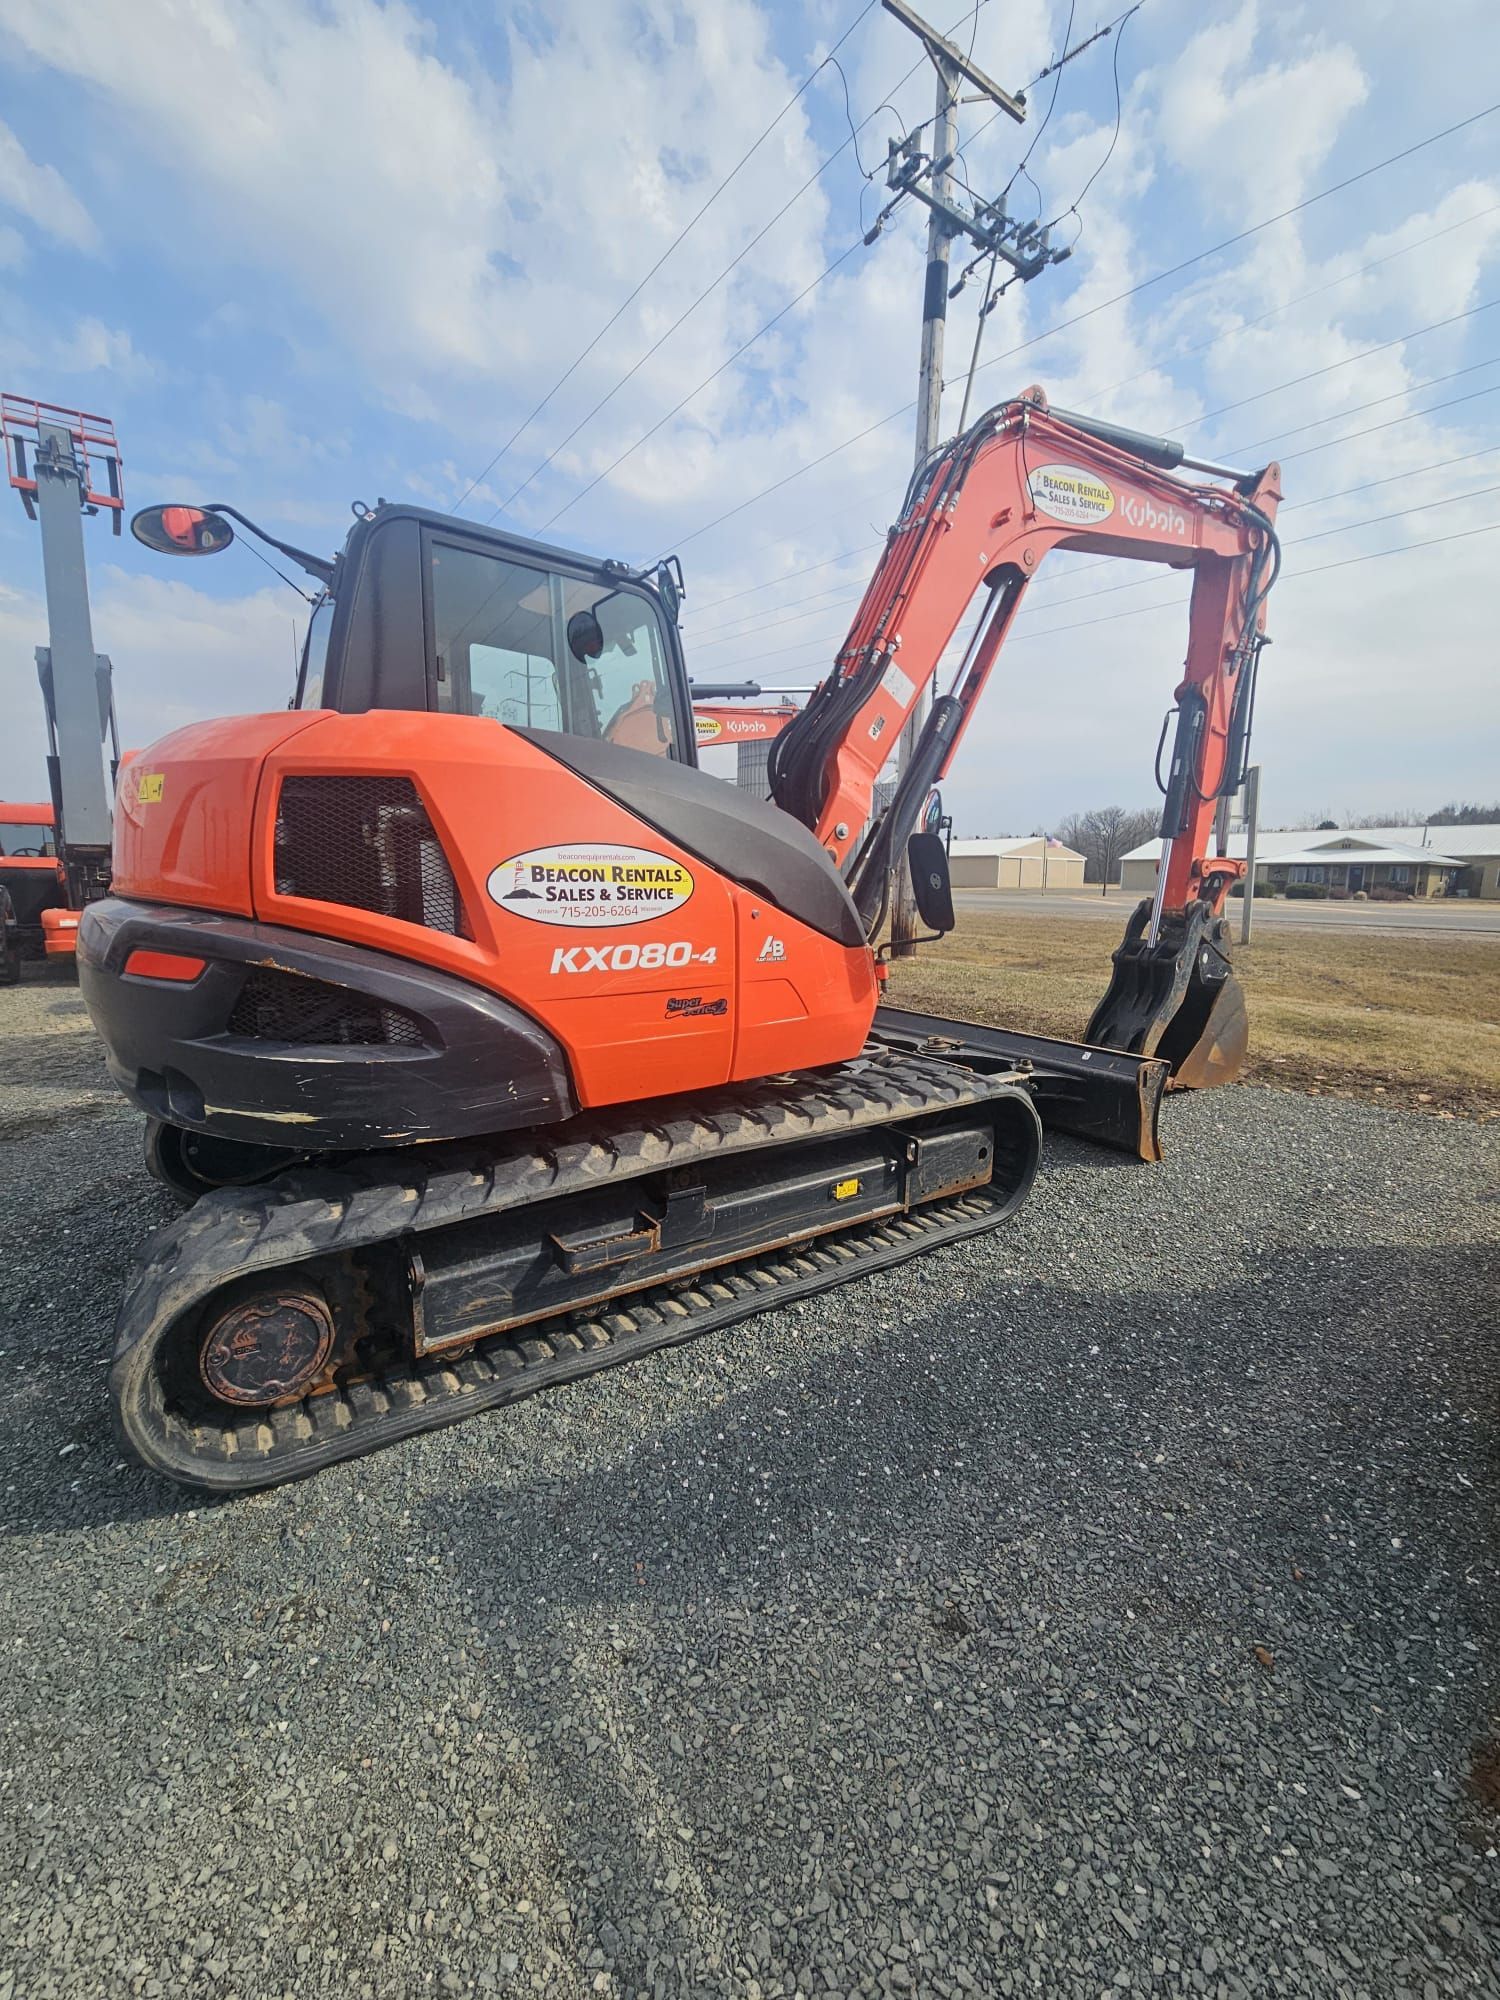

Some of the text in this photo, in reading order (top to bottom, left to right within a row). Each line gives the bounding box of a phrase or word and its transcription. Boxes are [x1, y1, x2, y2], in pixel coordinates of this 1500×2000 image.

[1043, 475, 1075, 493] BEACON
[1077, 482, 1110, 500] RENTALS
[1049, 490, 1105, 512] SALES & SERVICE
[1120, 495, 1185, 535] Kubota
[726, 720, 767, 733] Kubota
[531, 865, 682, 882] BEACON RENTALS
[545, 885, 674, 902] SALES & SERVICE
[560, 905, 639, 918] 715-205-6264
[550, 941, 717, 975] KX080-4
[667, 997, 702, 1011] Super
